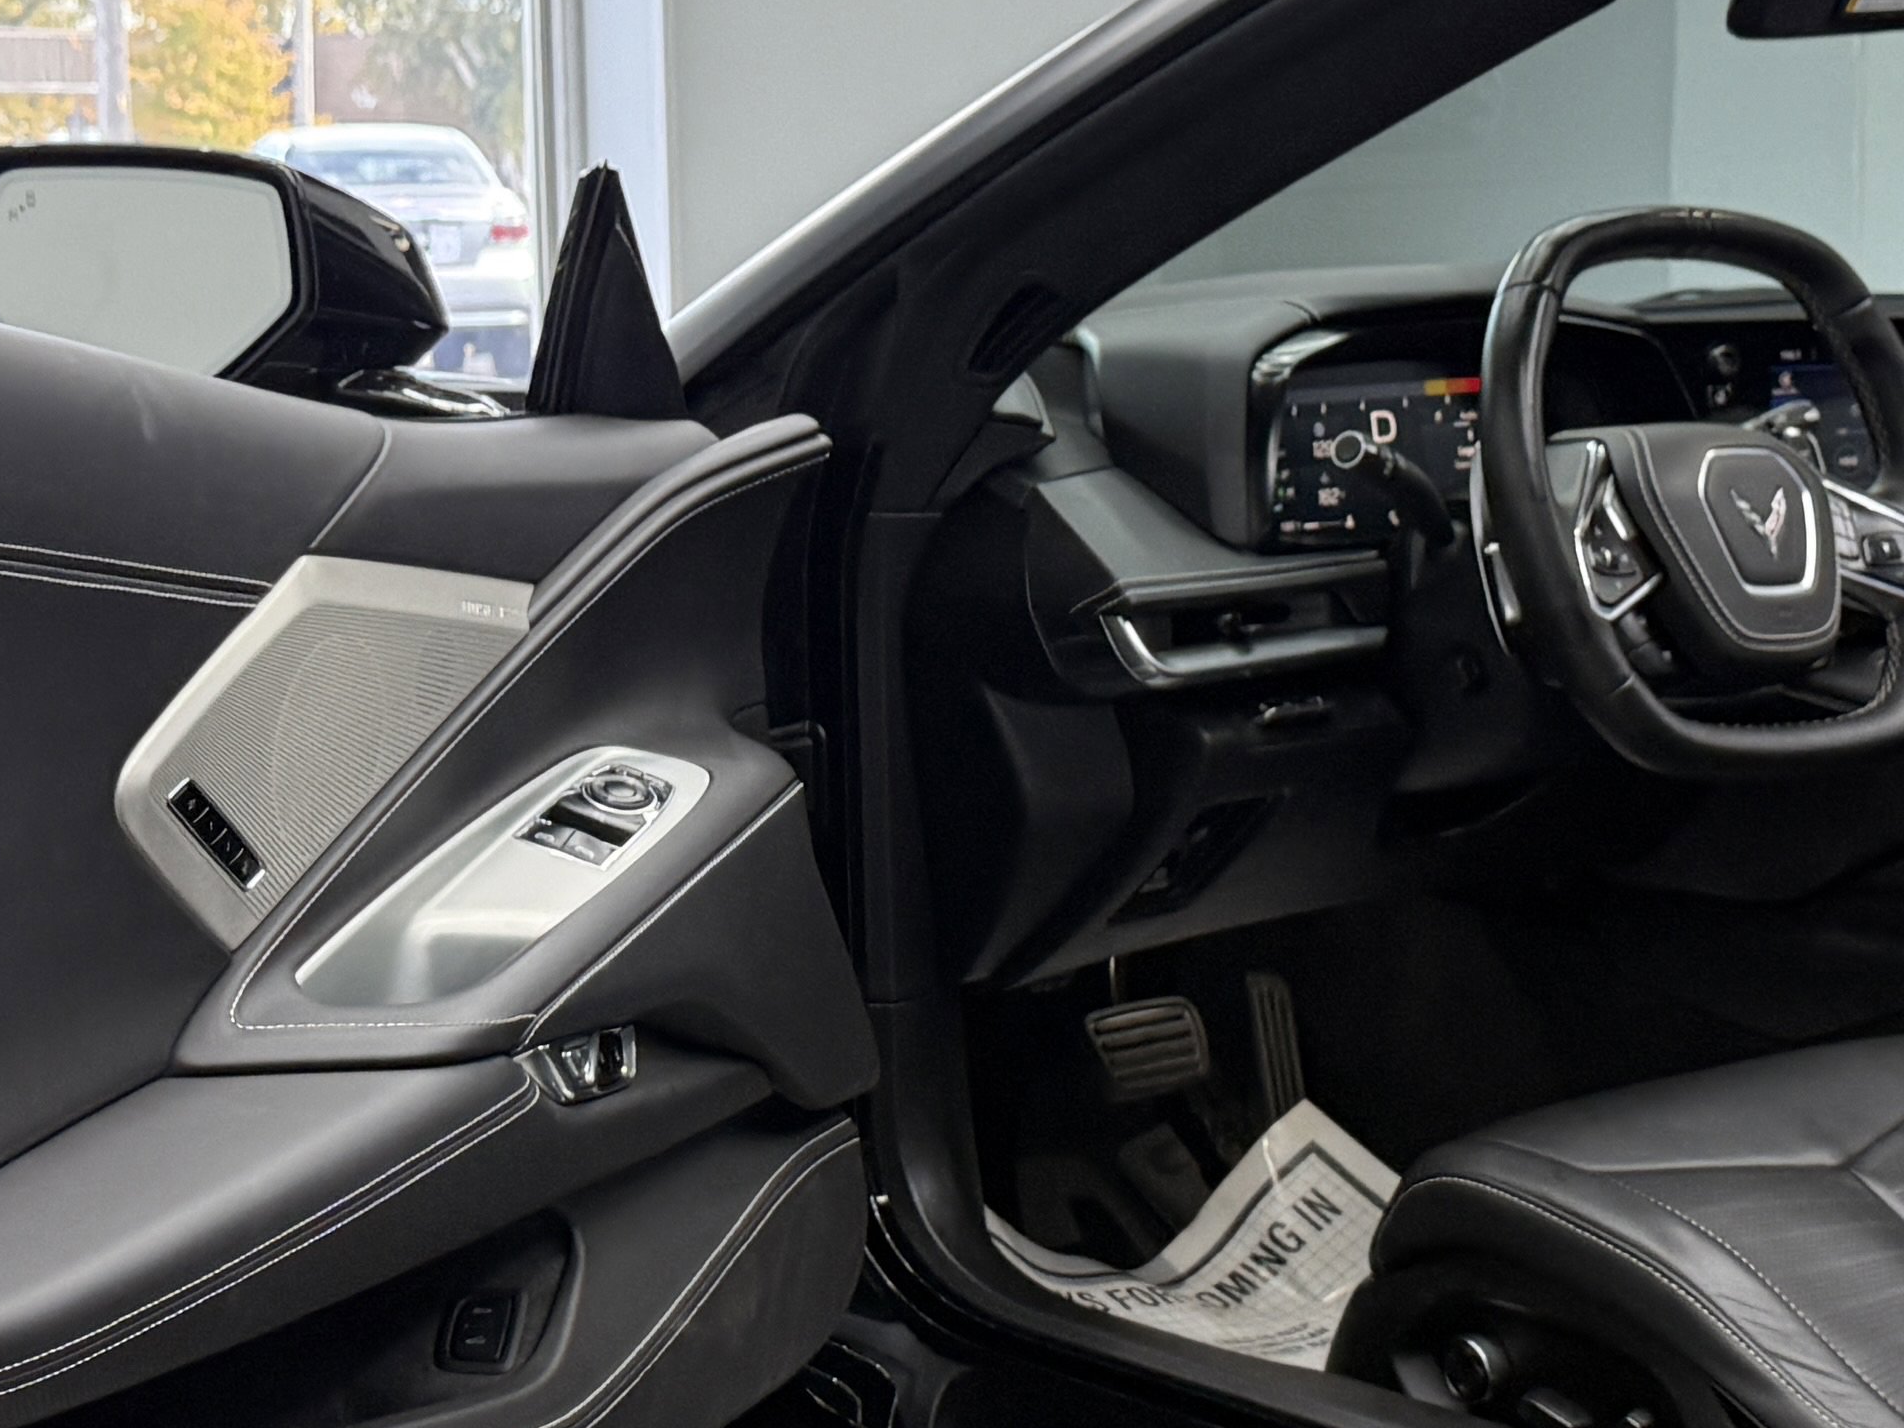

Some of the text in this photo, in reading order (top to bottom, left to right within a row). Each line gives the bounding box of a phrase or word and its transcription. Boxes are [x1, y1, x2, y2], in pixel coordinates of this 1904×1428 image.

[1369, 409, 1397, 444] D
[1195, 1221, 1307, 1310] OMING
[1292, 1187, 1343, 1232] IN
